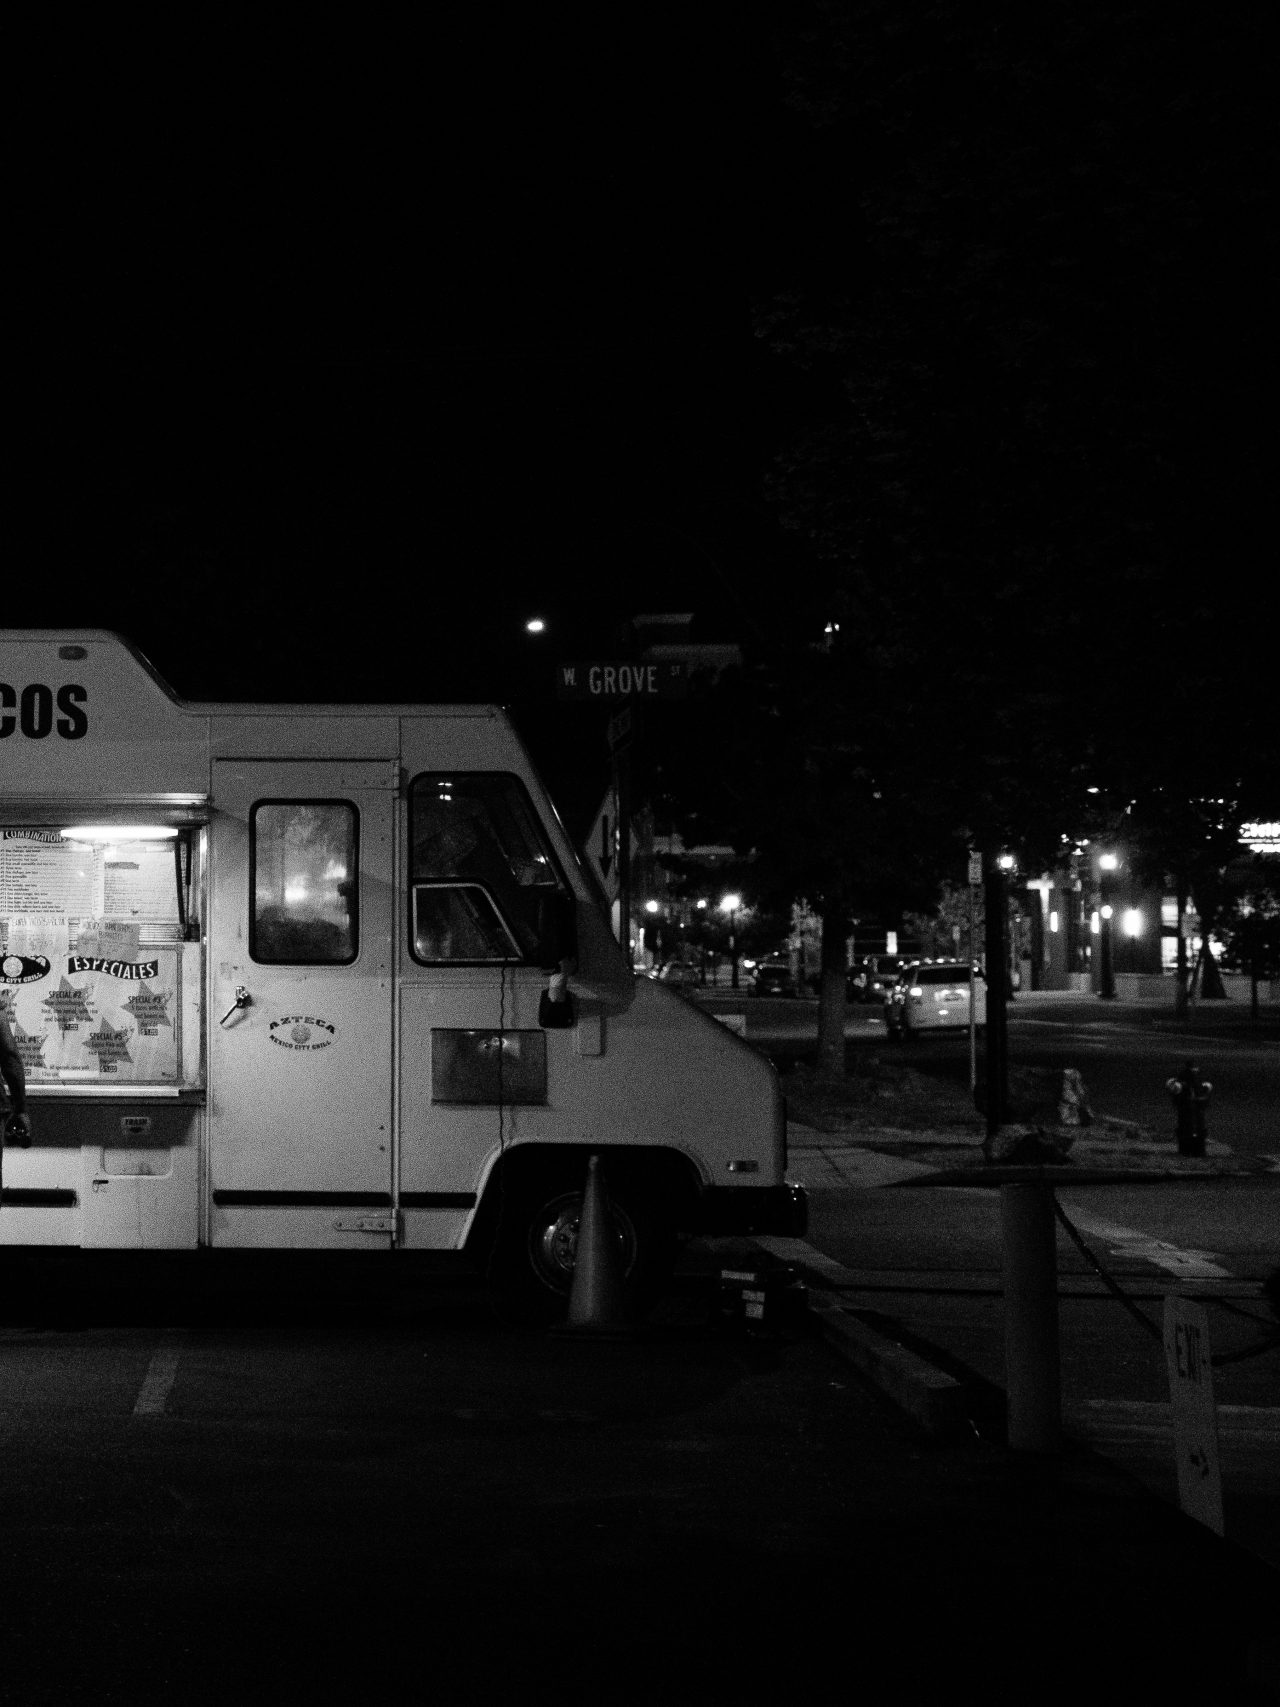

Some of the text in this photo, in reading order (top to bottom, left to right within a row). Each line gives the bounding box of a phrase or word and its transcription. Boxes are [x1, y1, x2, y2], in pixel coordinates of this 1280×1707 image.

[588, 665, 658, 695] GROVE
[670, 664, 681, 677] ST
[74, 957, 155, 979] ESPECIALES
[6, 976, 22, 984] CITY
[48, 990, 82, 999] SPECIAL #2
[128, 995, 151, 1004] SPECIAL
[269, 1016, 335, 1035] AZTECA
[89, 1032, 113, 1041] SPECIAL
[269, 1034, 293, 1049] MEXICO
